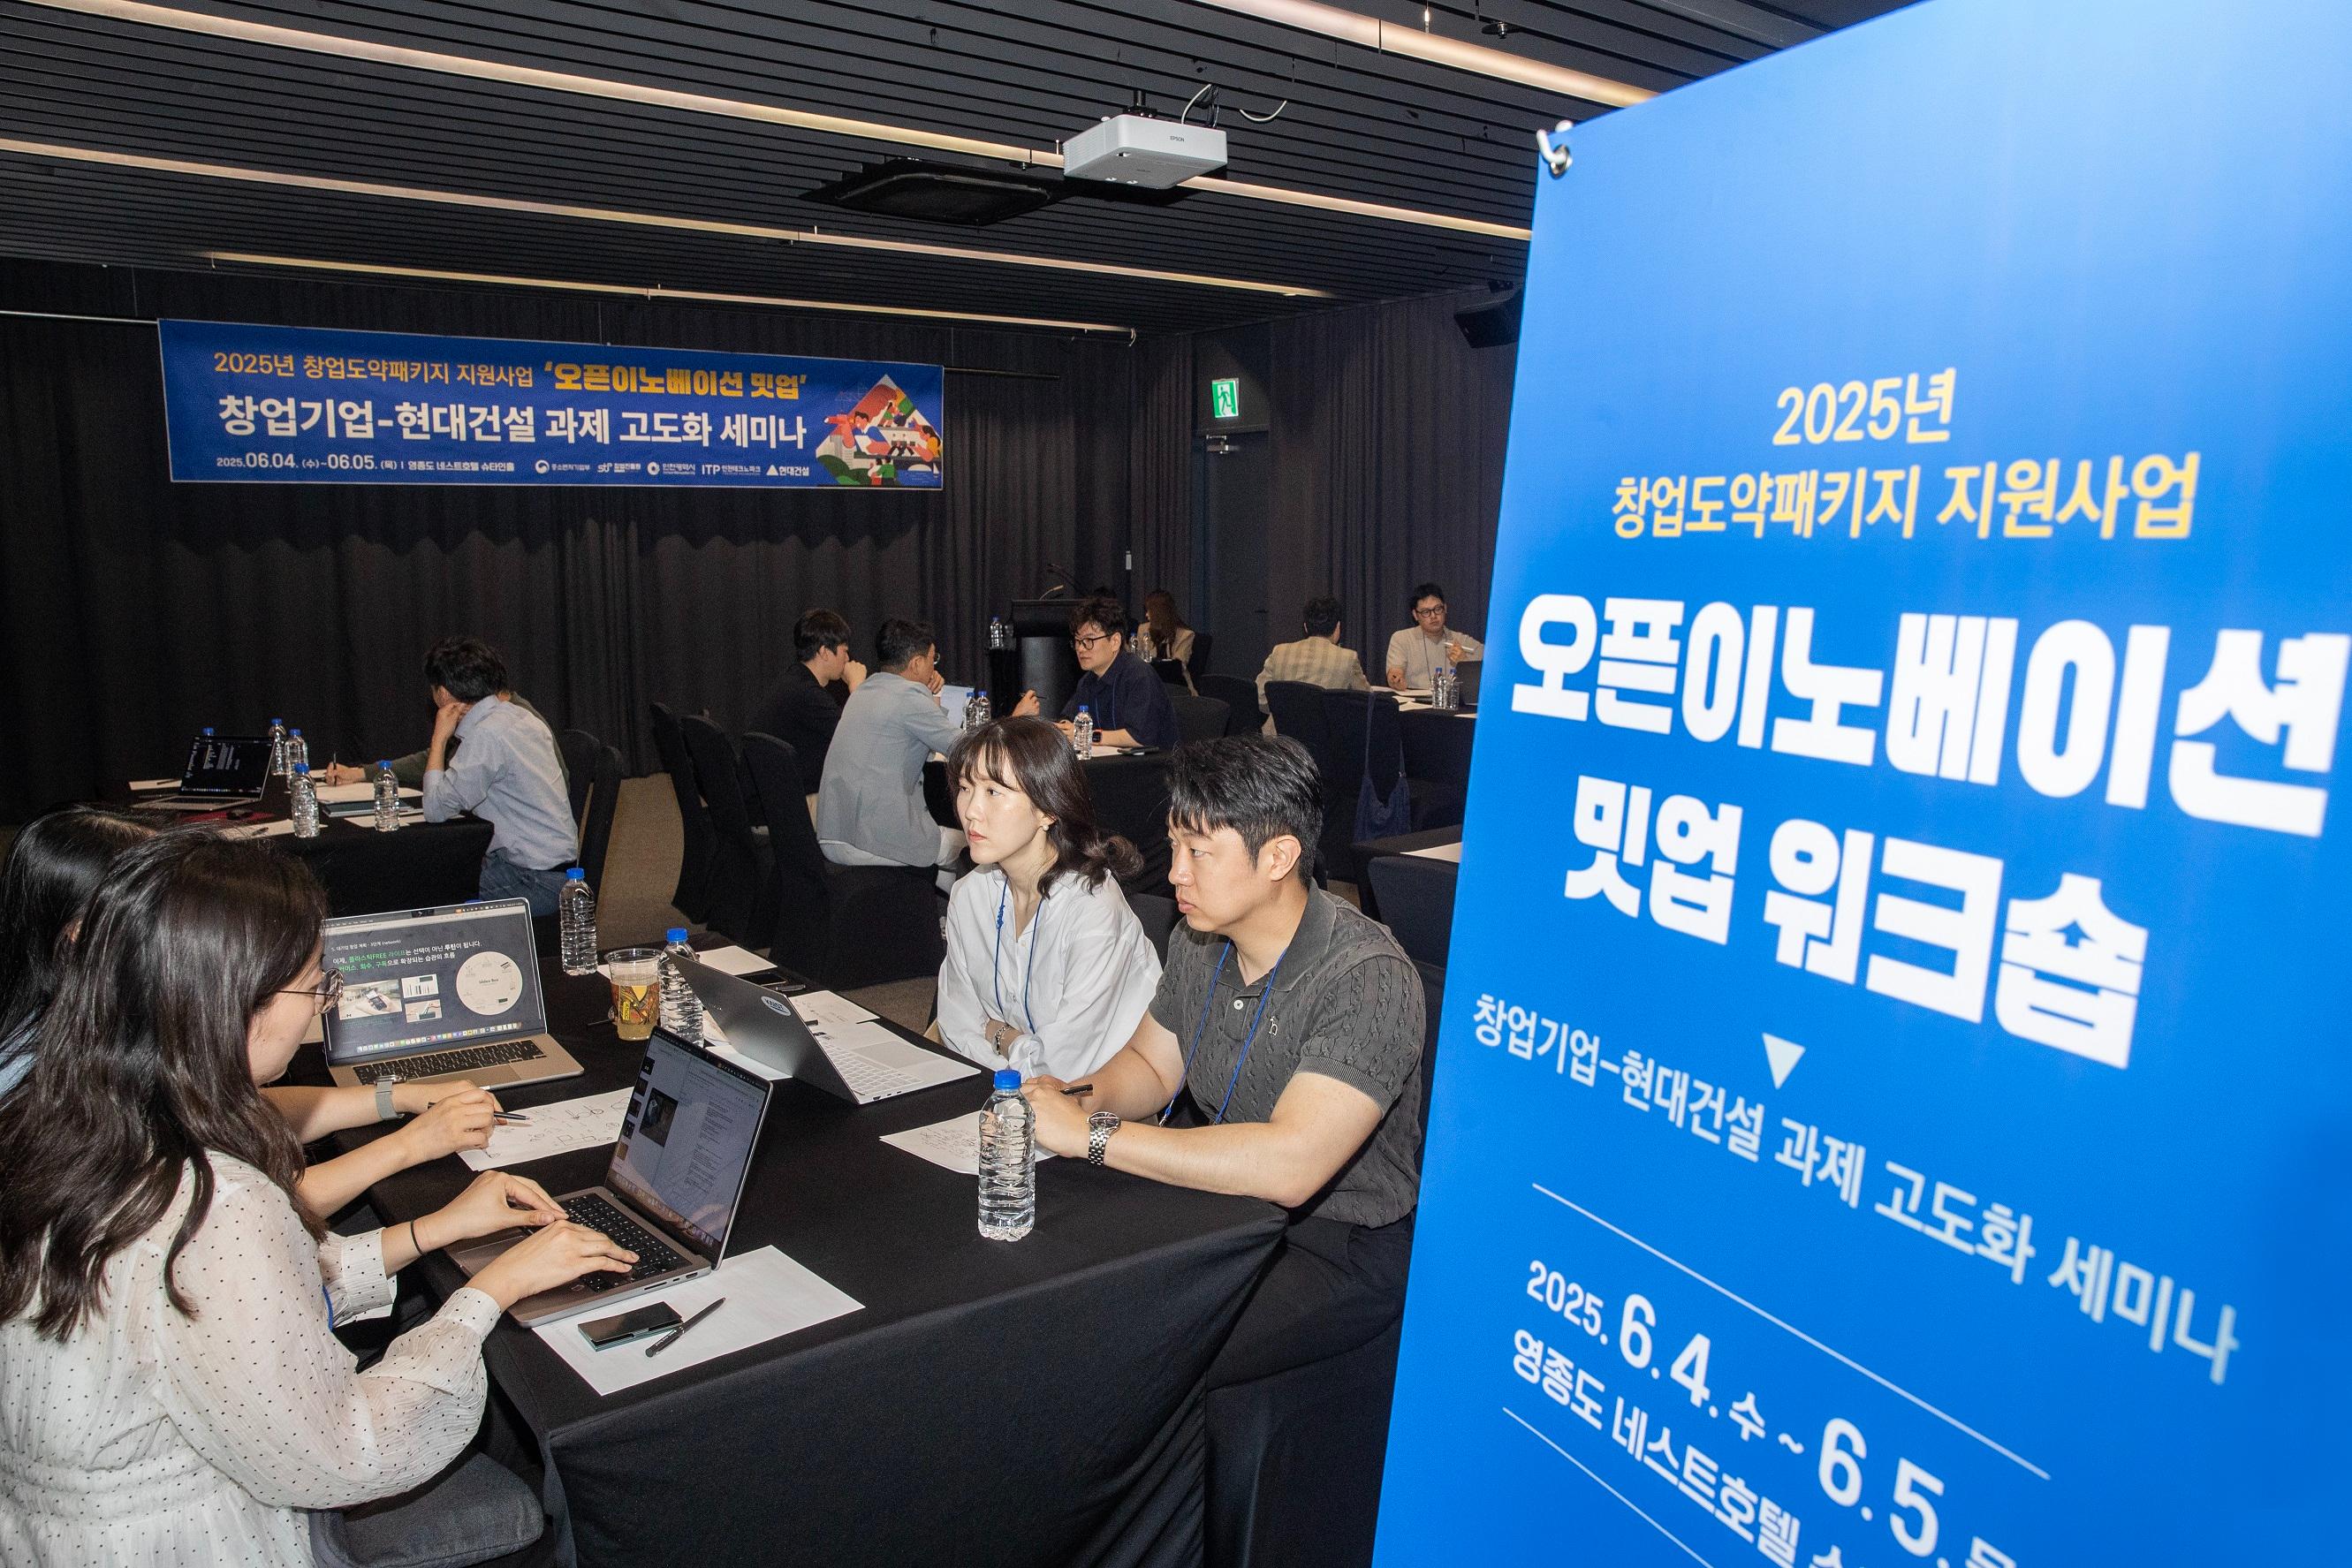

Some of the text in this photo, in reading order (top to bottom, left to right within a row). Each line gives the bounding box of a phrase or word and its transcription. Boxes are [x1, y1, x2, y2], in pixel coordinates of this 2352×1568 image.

[214, 352, 294, 377] 2025년
[303, 355, 451, 384] 창업도약패키지
[457, 364, 534, 388] 지원사업
[218, 395, 808, 450] 창업기업-현대건설 과제 고도화 세미나
[1772, 367, 1957, 445] 2025년
[702, 464, 721, 475] ITP
[778, 466, 810, 477] 현대건설
[1612, 451, 2200, 540] 창업도약패키지 지원사업
[1511, 593, 2351, 838] 오픈이노베이션
[1564, 775, 2148, 1070] 밋업 워크숍
[348, 952, 387, 963] 플라스틱FREE
[399, 956, 424, 965] 확장되는
[425, 953, 443, 962] 습관의
[1473, 993, 2239, 1384] 창업기업-현대건설 과제 고도화 세미나
[1512, 1329, 1801, 1568] 영종도 네스트호텔
